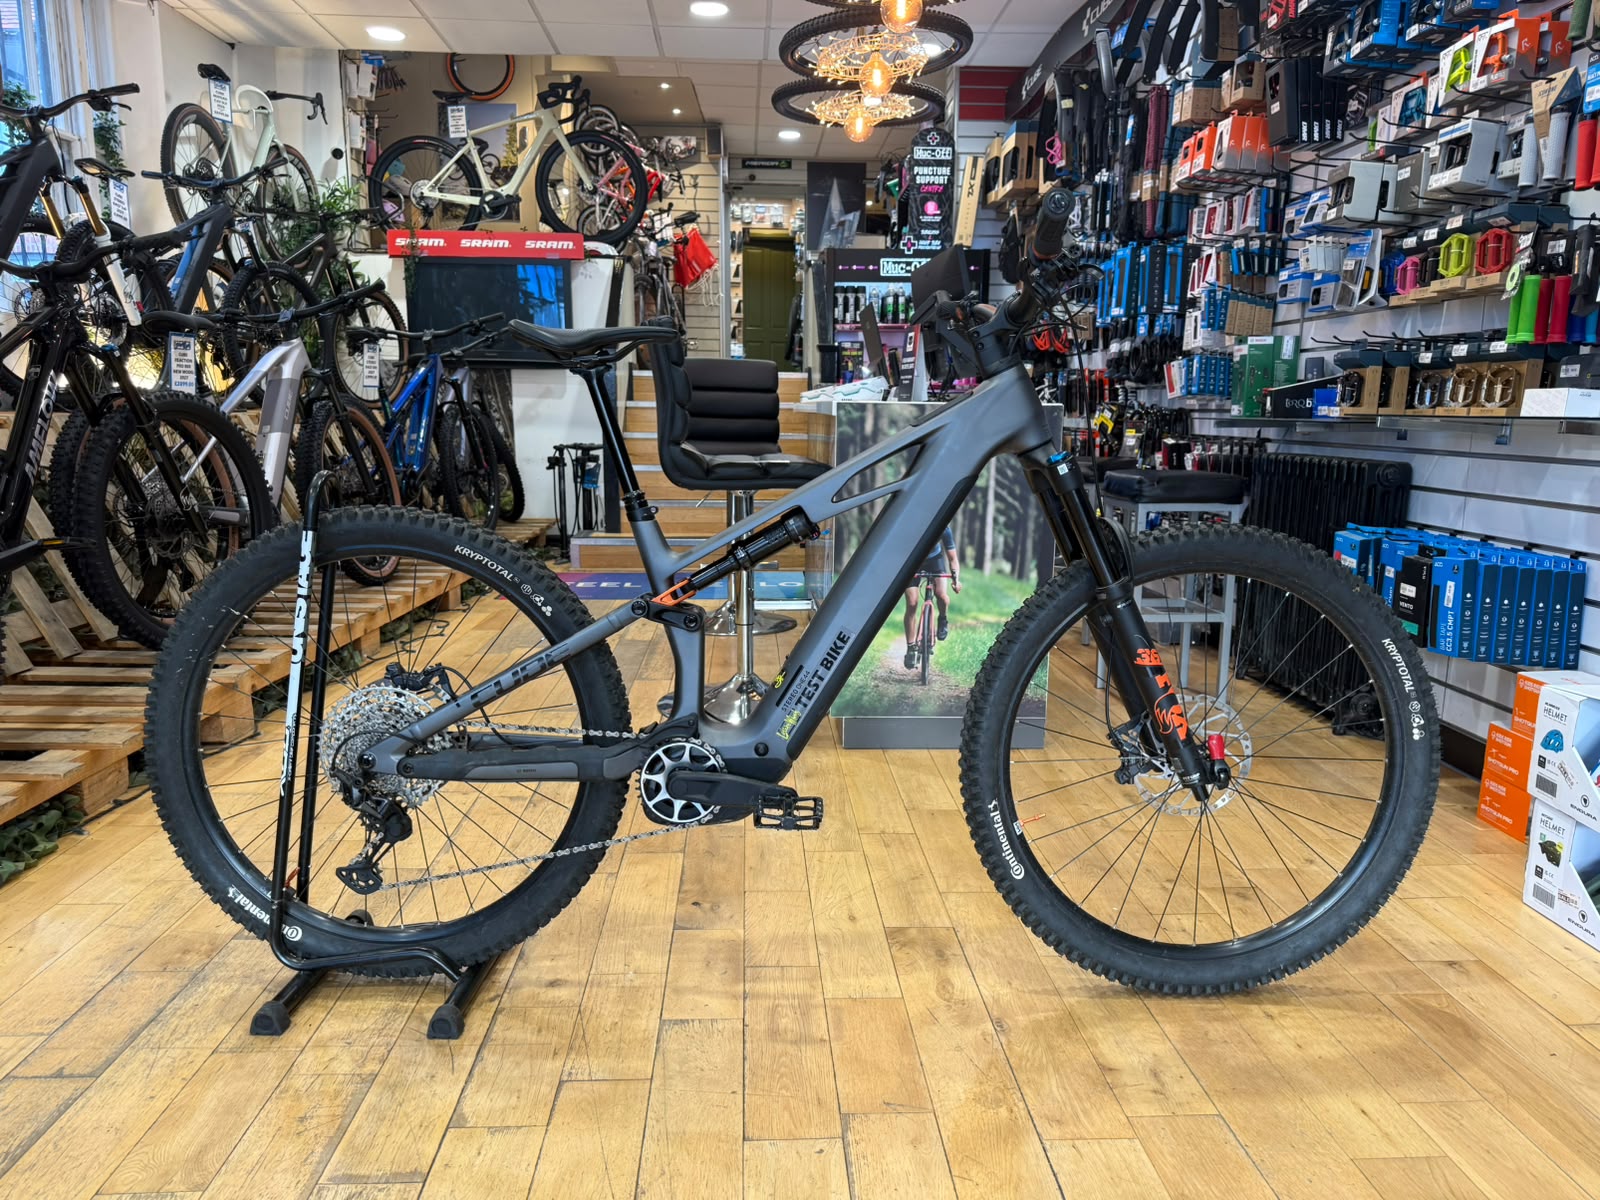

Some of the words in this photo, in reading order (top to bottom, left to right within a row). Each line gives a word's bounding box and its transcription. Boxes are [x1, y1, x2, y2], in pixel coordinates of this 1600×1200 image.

[916, 149, 951, 158] Muc-Off
[914, 166, 951, 175] PUNCTURE
[916, 176, 948, 184] SUPPORT
[460, 239, 509, 248] SRAM
[525, 240, 574, 249] SRAM
[454, 544, 514, 582] KRYPTOTAL
[795, 669, 825, 709] TEST
[820, 630, 851, 672] BIKE
[1381, 638, 1415, 693] KRYPTOTAL
[1543, 706, 1568, 722] HELMET
[1508, 766, 1519, 776] PRO
[1502, 815, 1513, 825] PRO
[1570, 803, 1597, 821] ENDURA
[1540, 818, 1566, 836] HELMET
[988, 809, 1025, 879] Continental
[1568, 917, 1596, 938] ENDURA
